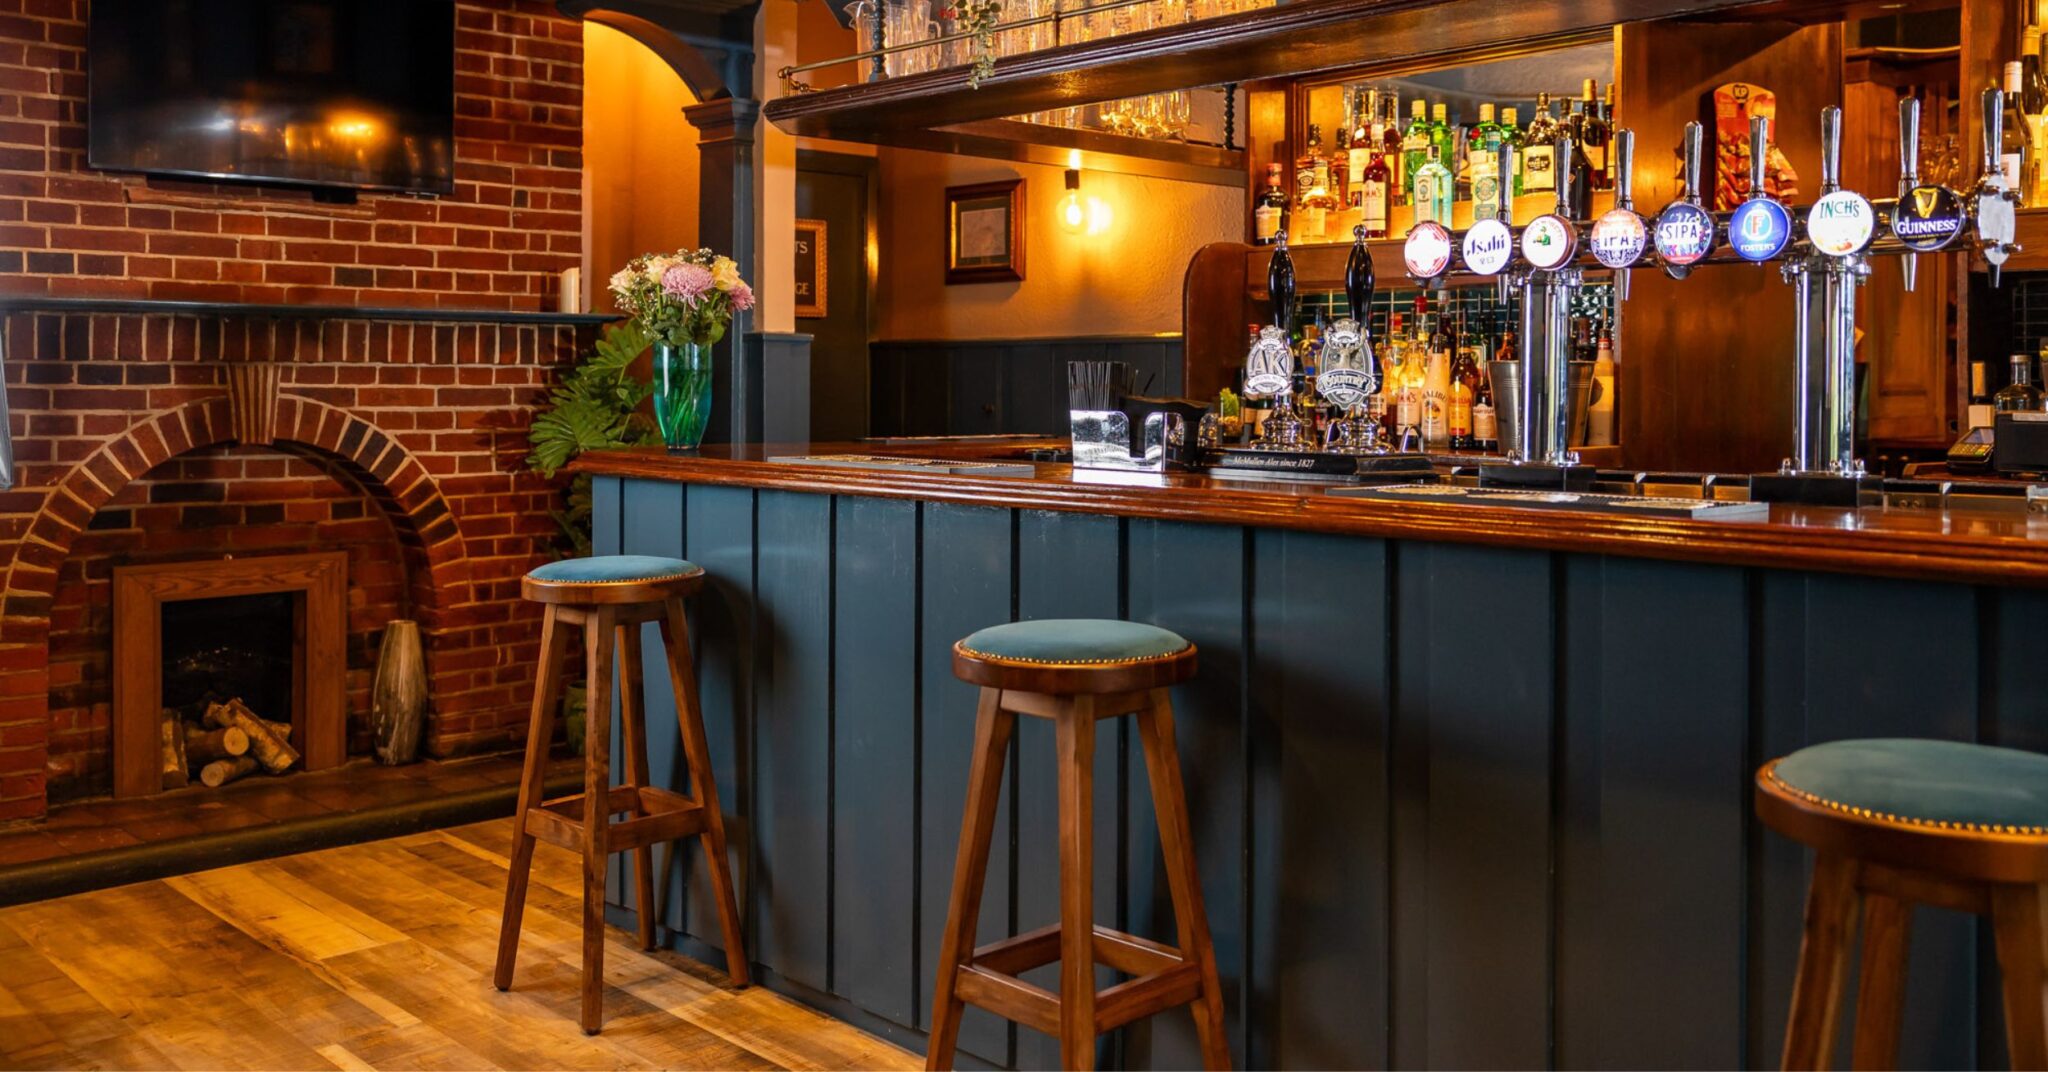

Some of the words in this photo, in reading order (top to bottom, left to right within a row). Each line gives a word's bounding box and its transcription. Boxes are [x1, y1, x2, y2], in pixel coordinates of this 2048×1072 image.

[1820, 200, 1859, 218] INCH'S
[1665, 224, 1697, 239] SIPA
[1897, 216, 1957, 234] GUINNESS
[1466, 234, 1504, 255] Asahi
[1740, 243, 1775, 252] FOSTER'S
[1249, 350, 1287, 378] AK
[1233, 455, 1264, 465] McMullen
[1265, 458, 1279, 466] Ales
[1280, 458, 1297, 467] since
[1298, 459, 1315, 469] 1827
